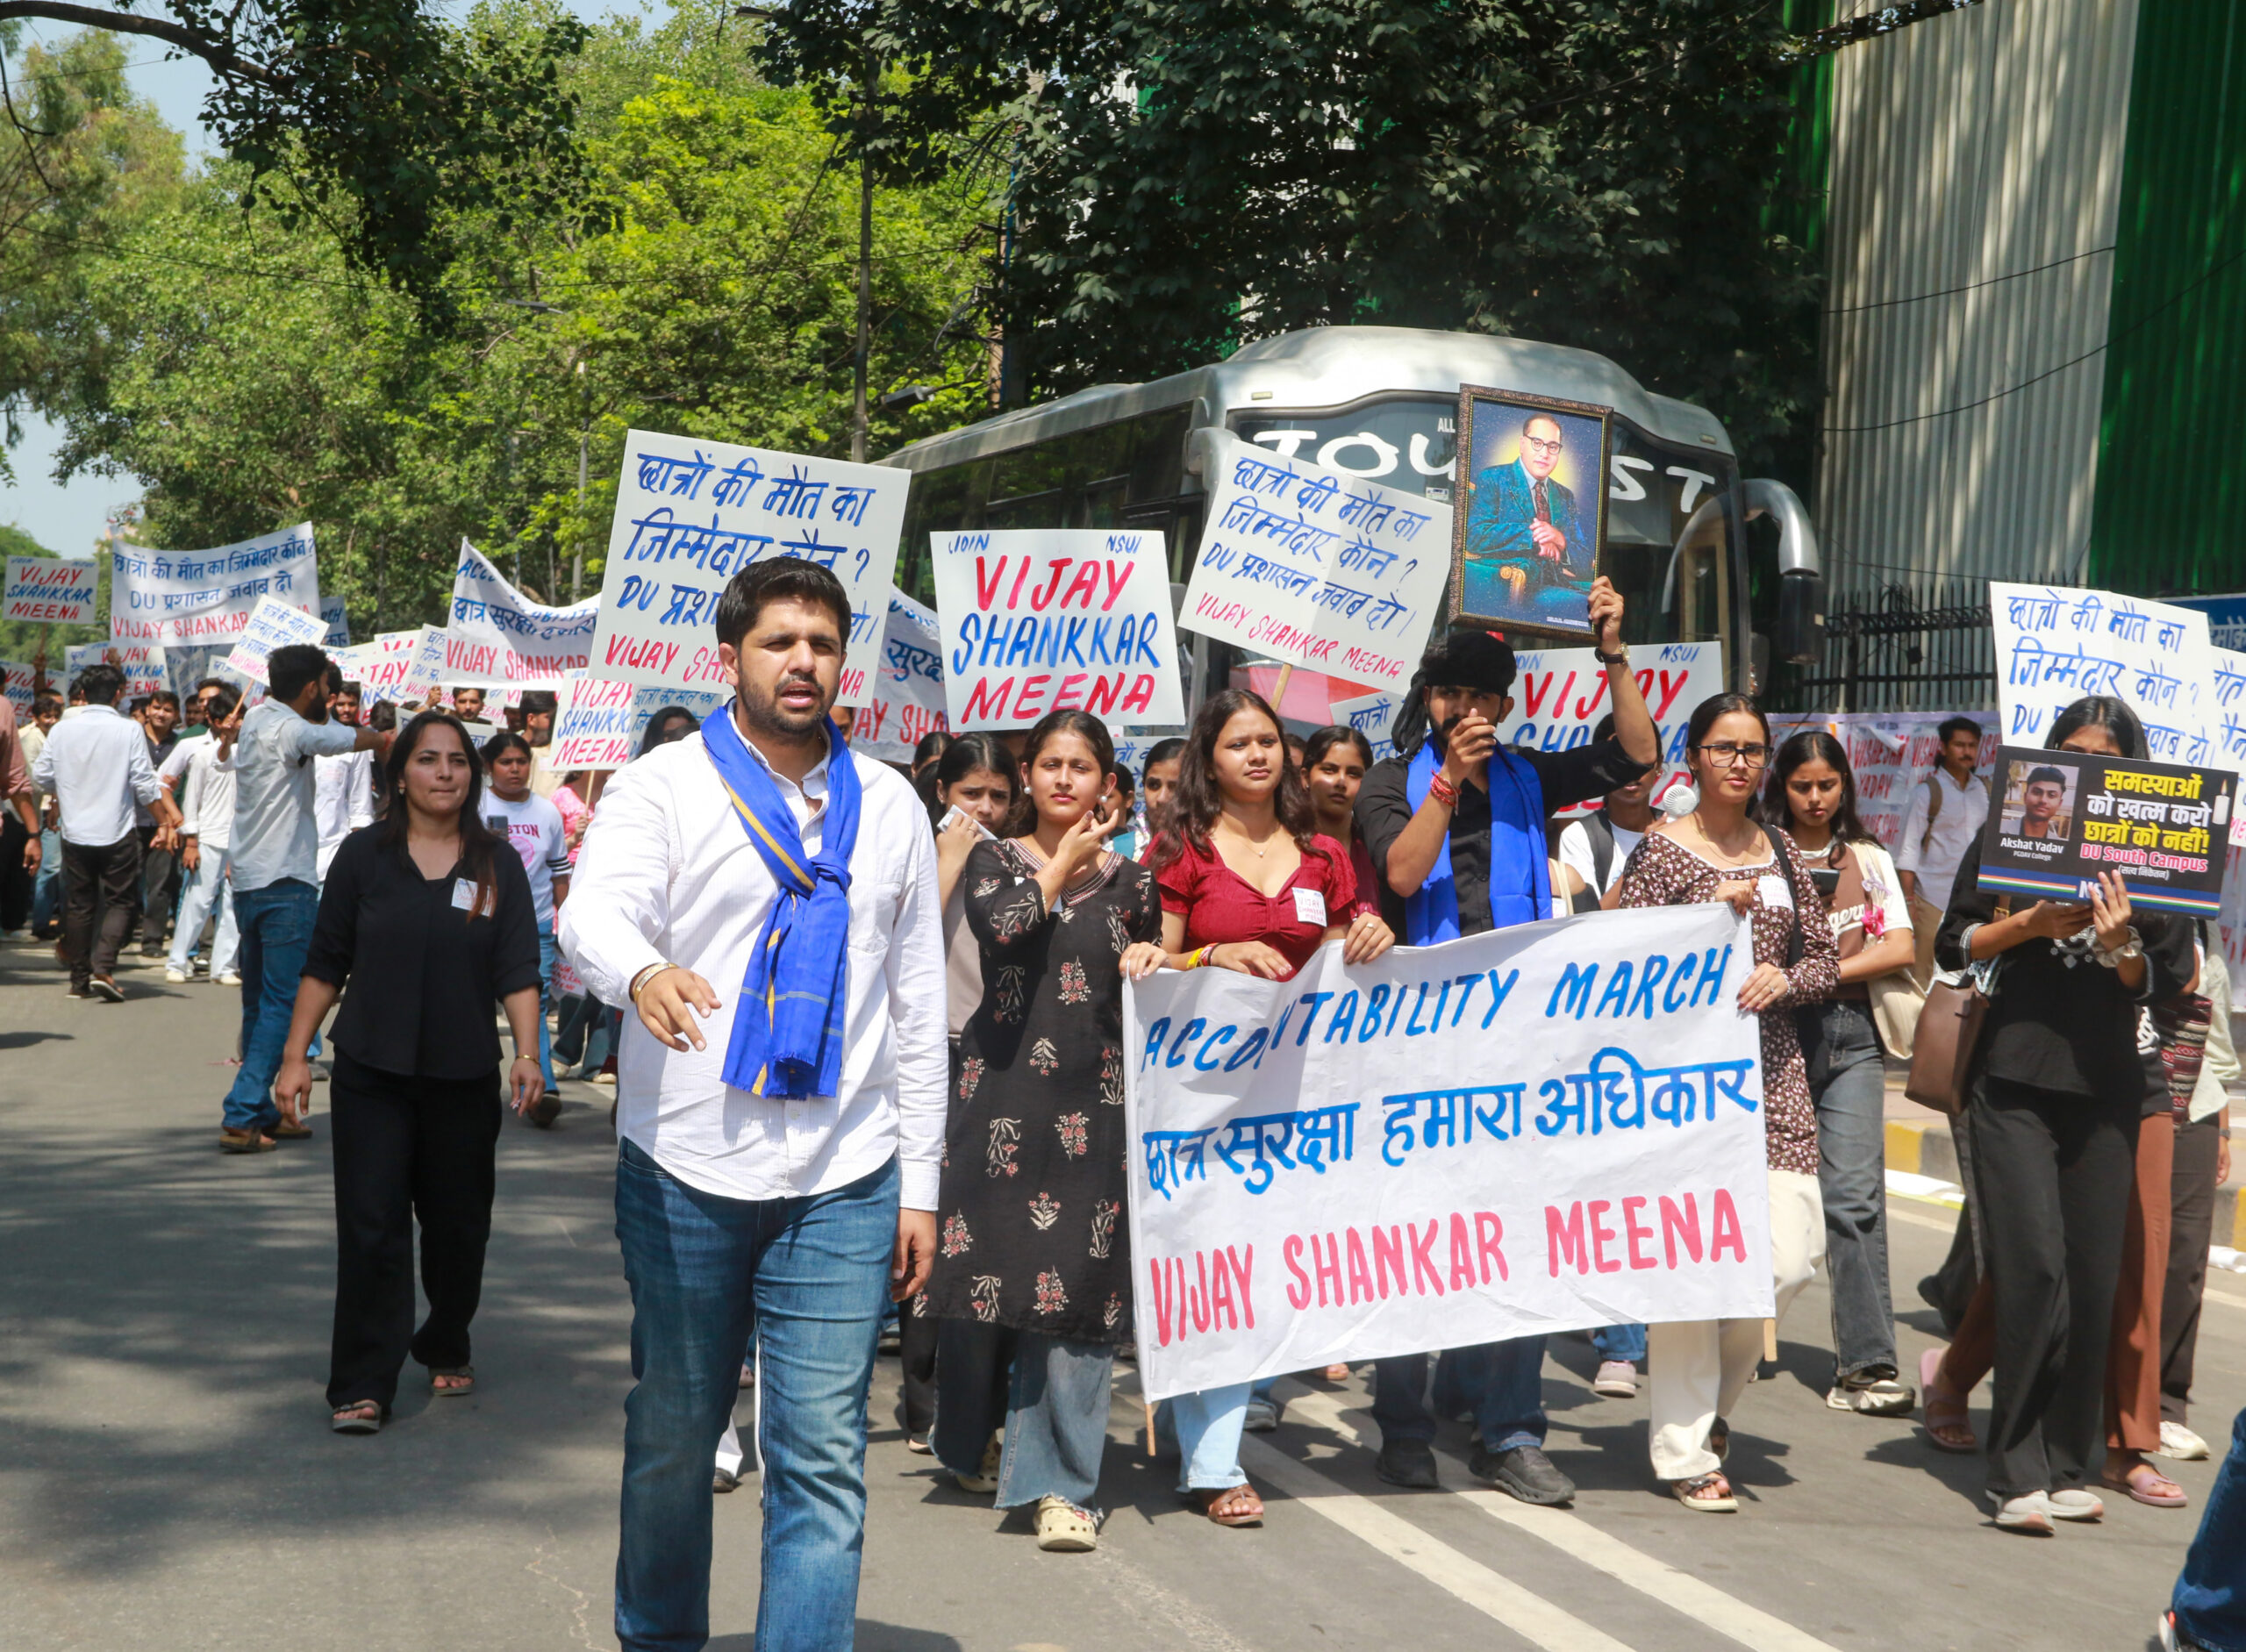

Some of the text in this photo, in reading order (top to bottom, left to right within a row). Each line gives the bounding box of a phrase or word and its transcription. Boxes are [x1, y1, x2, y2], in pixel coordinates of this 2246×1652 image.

[1437, 418, 1456, 433] ALL
[637, 449, 876, 526] छात्रों की मौत का
[1296, 475, 1341, 513] की
[1338, 489, 1396, 535] मौत
[1393, 510, 1433, 543] का
[152, 556, 173, 580] की
[176, 556, 205, 581] मौत
[203, 559, 225, 576] का
[280, 534, 307, 560] कौन
[624, 507, 774, 577] जिम्मेदार
[854, 547, 870, 590] ?
[948, 533, 1142, 554] JOIN NSUI
[1219, 496, 1341, 562] जिम्मेदार
[1338, 533, 1399, 580] कौन
[6, 584, 94, 605] SHANKKAR
[19, 566, 83, 586] VIJAY
[130, 569, 293, 611] DU प्रशासन जवाब दो
[617, 575, 660, 611] DU
[976, 554, 1135, 612] VIJAY
[1201, 542, 1237, 571] DU
[1231, 552, 1318, 597] प्रशासन
[1311, 581, 1374, 619] जवाब
[10, 601, 81, 619] MEENA
[112, 615, 164, 639] VIJAY
[454, 597, 487, 624] छात्र
[2006, 588, 2069, 632] छात्रों
[2071, 594, 2105, 633] की
[2107, 599, 2151, 644] मौत
[2156, 619, 2186, 654] का
[605, 633, 681, 676] VIJAY
[952, 611, 1162, 676] SHANKKAR
[1195, 591, 1405, 679] VIJAY SHANKAR MEENA
[1659, 645, 1701, 663] NSUI
[447, 638, 497, 676] VIJAY
[2008, 636, 2127, 701] जिम्मेदार
[2133, 659, 2183, 710] कौन
[961, 672, 1156, 725] MEENA
[2011, 704, 2043, 735] DU
[2103, 769, 2204, 800] समस्याओं
[2086, 790, 2115, 817] को
[2116, 797, 2169, 823] खत्म
[2170, 801, 2213, 827] करो
[2000, 837, 2064, 855] Akshat Yadav
[2031, 852, 2053, 862] College
[2084, 819, 2134, 844] छात्रों
[2132, 822, 2161, 848] को
[2162, 826, 2211, 855] नहीं!
[2079, 842, 2209, 873] DU South Campus
[1141, 943, 1734, 1074] ACCOTABILITY MARCH
[1380, 1082, 1528, 1167] हमारा
[1534, 1047, 1759, 1137] अधिकार
[1149, 1187, 1748, 1348] VIJAY SHANKAR MEENA
